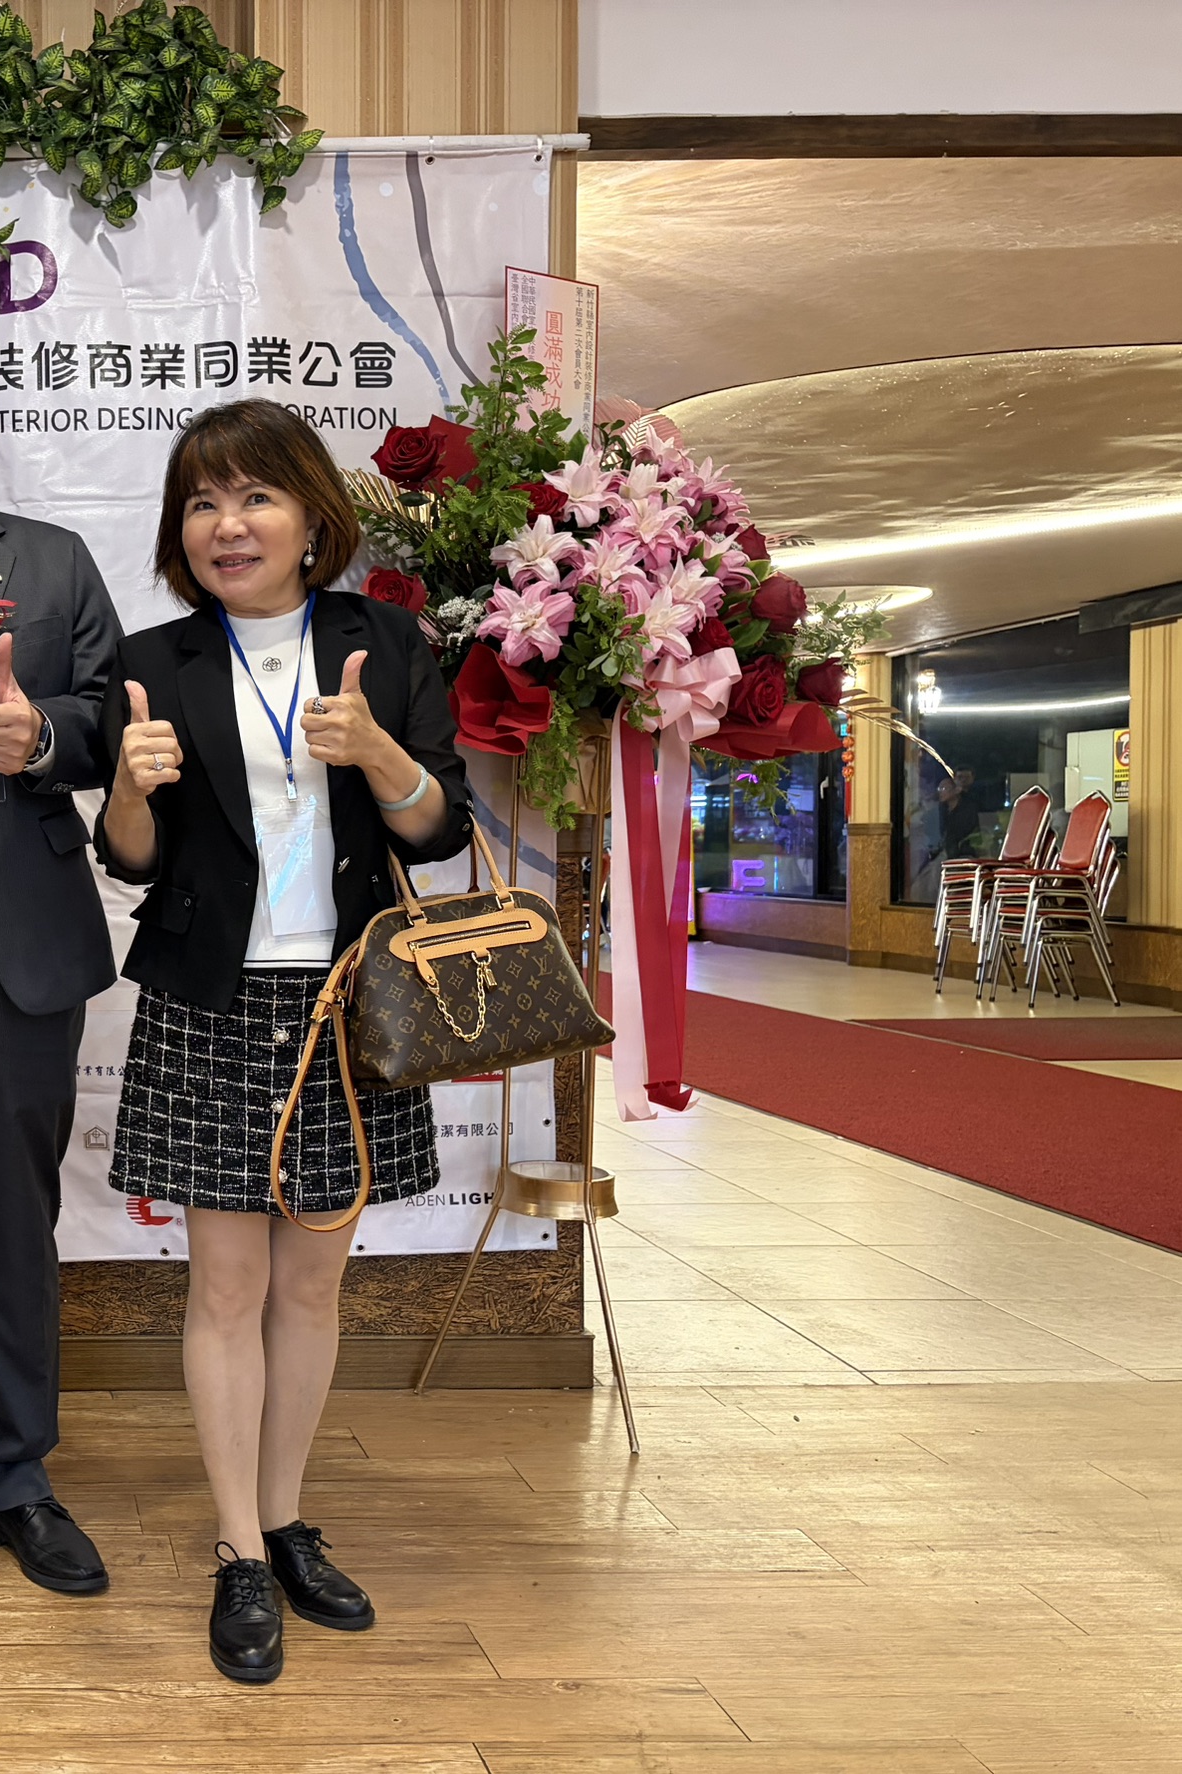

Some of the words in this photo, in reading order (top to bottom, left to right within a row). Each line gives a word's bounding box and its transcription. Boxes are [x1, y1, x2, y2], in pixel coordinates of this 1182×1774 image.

[541, 310, 564, 411] 圓滿成功
[405, 1194, 446, 1207] ADEN
[449, 1192, 495, 1205] LIGH
